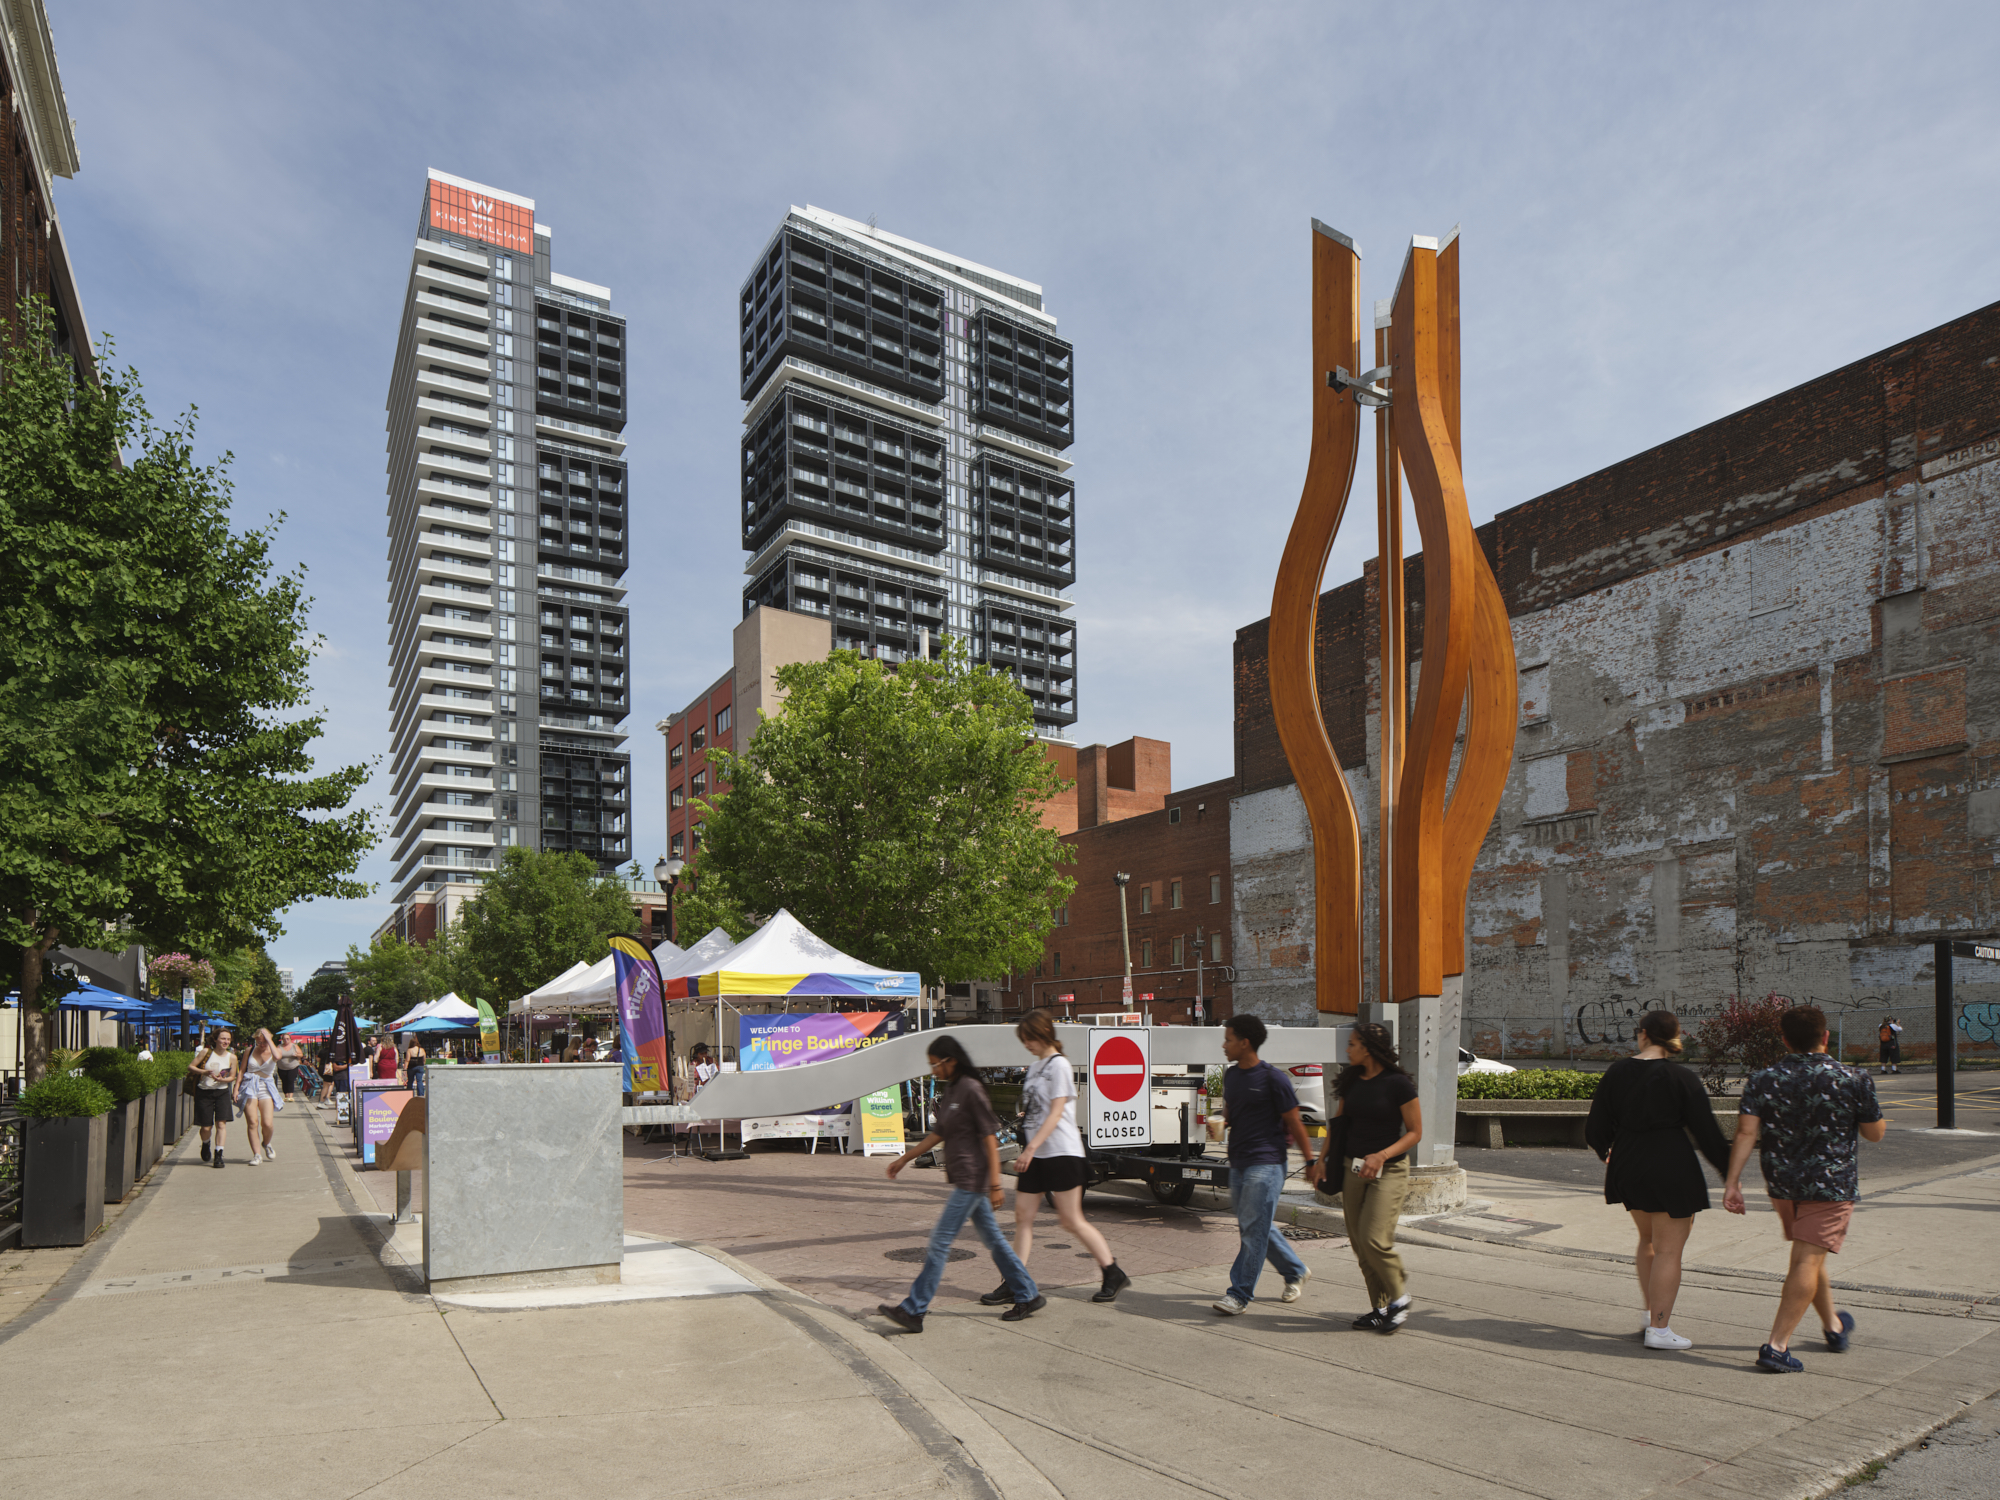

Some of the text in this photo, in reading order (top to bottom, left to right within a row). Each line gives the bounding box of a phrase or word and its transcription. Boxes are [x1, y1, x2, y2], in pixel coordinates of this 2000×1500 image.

[435, 210, 527, 243] KING WILLIAM
[461, 228, 500, 243] URBAN RENTALS
[1974, 945, 1995, 959] CAUTION
[873, 976, 905, 992] Fringe
[626, 968, 651, 1020] Fringe
[749, 1025, 801, 1035] WELCOME TO
[750, 1033, 889, 1055] Fringe Boulevard
[751, 1062, 775, 1070] incite
[1103, 1110, 1137, 1122] ROAD
[1096, 1126, 1145, 1139] CLOSED
[104, 1259, 355, 1290] JAMES
